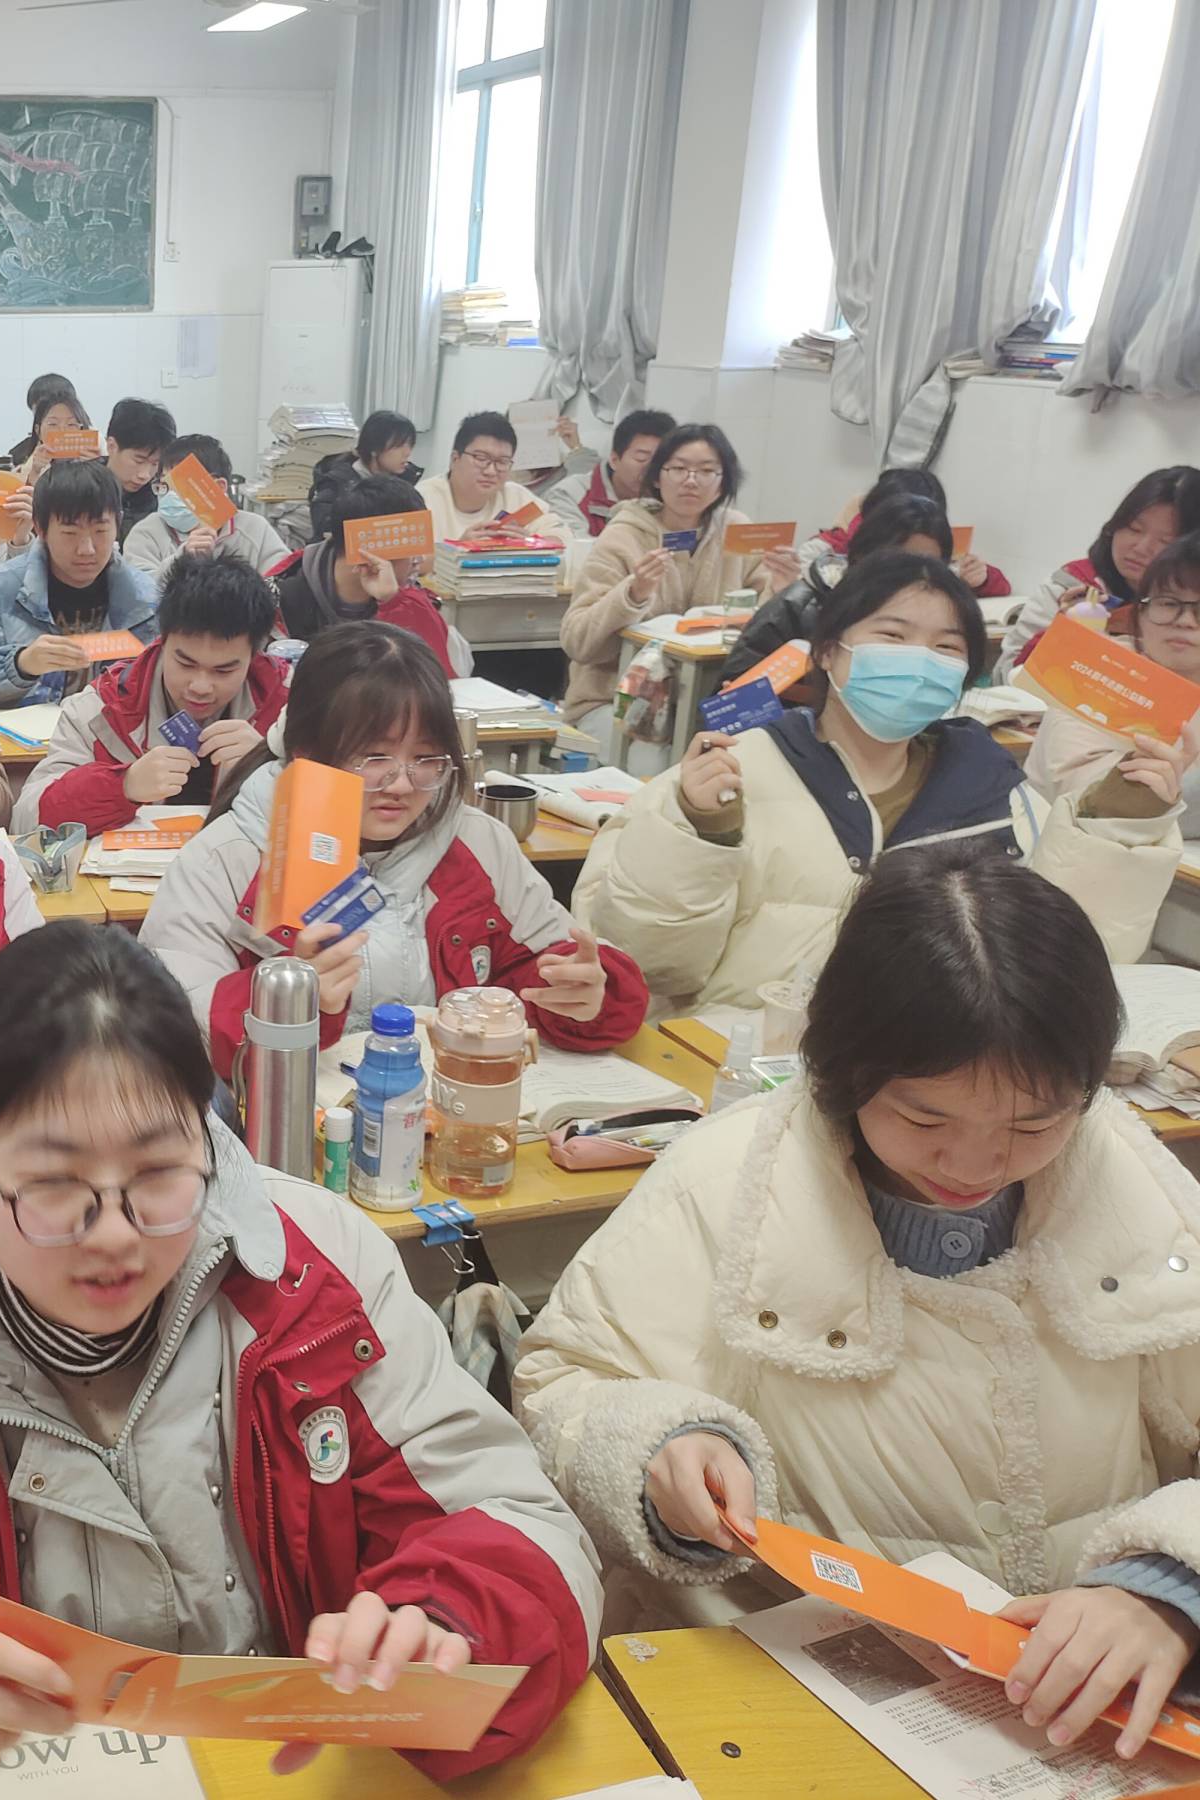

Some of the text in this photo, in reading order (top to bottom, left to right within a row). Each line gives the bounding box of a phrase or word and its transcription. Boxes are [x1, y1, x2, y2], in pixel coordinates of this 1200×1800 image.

[93, 1729, 167, 1765] up
[17, 1764, 79, 1782] WITH YOU
